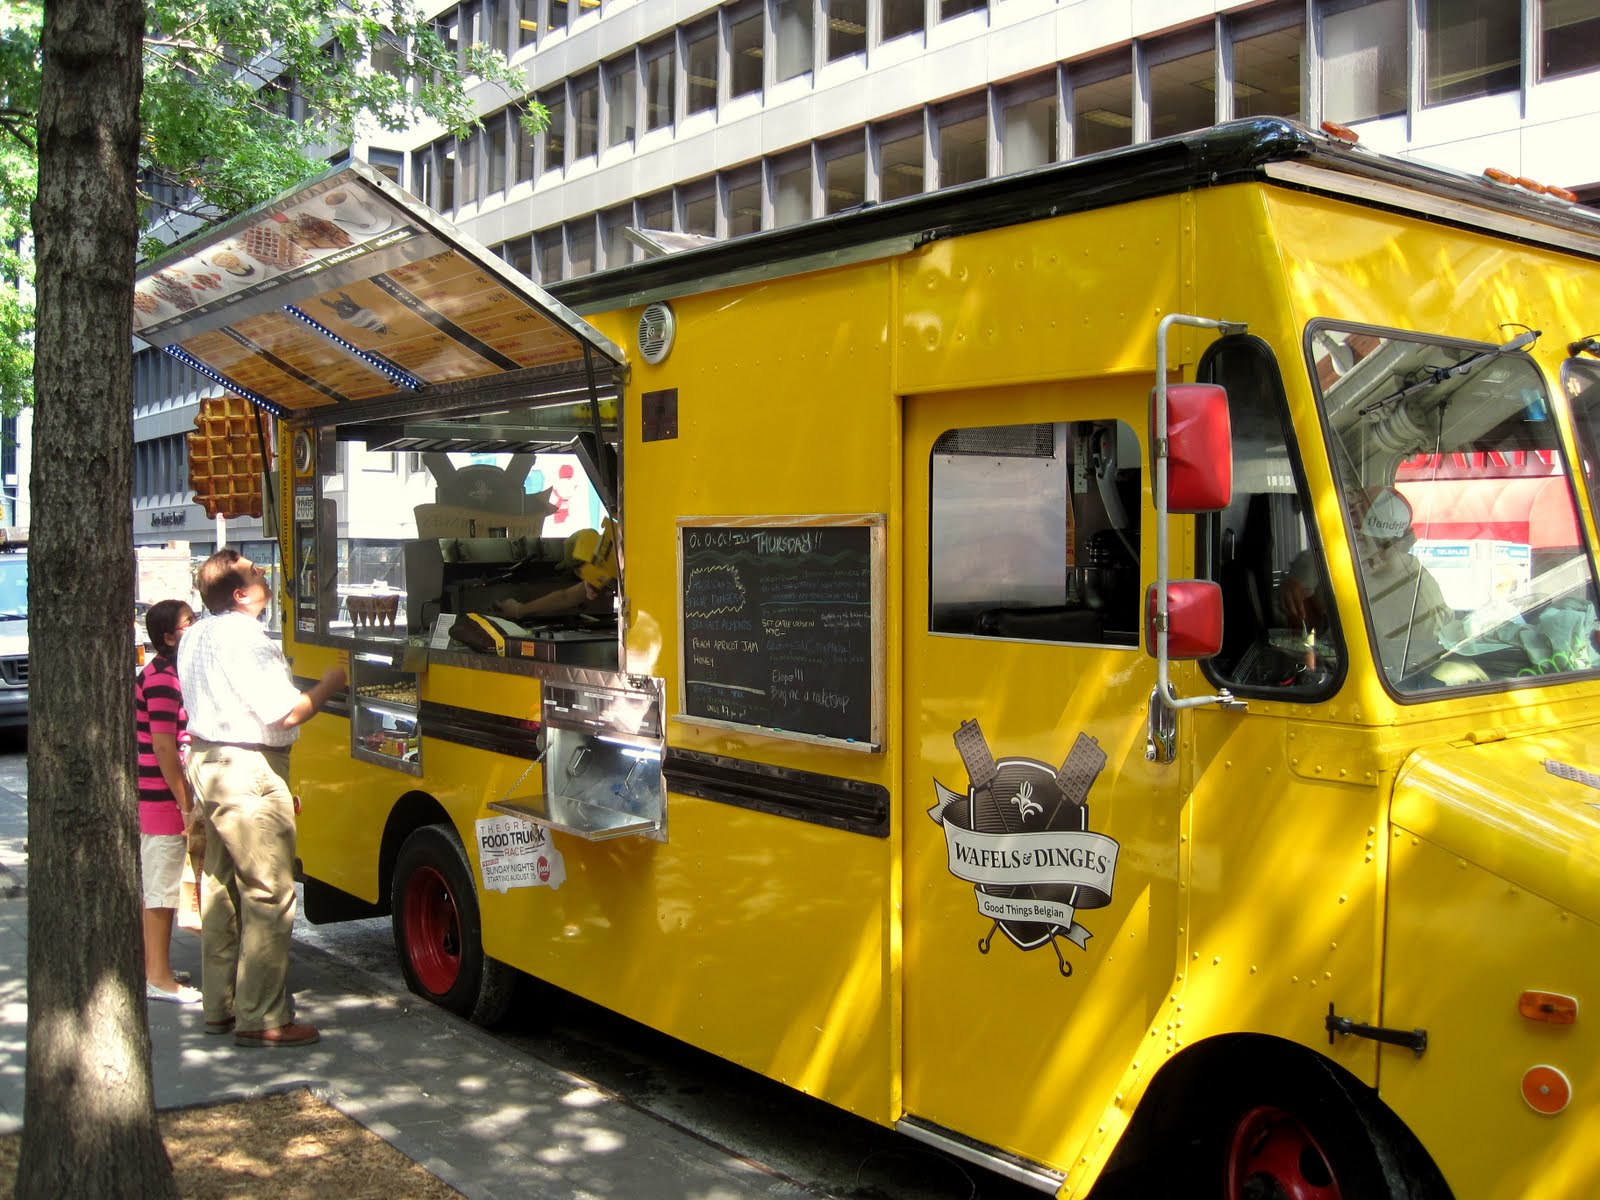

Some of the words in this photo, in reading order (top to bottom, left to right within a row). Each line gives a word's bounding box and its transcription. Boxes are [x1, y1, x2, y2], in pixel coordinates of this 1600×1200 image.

[692, 637, 711, 650] PEACH
[714, 640, 738, 652] APRICOT
[741, 641, 759, 653] JAM
[693, 654, 714, 667] HONEY
[480, 823, 502, 835] THE
[482, 834, 509, 849] FOOD
[504, 846, 526, 857] RACE
[954, 841, 1021, 869] WAFELS
[1022, 852, 1033, 866] &
[1033, 848, 1107, 875] DINGES
[486, 865, 510, 875] SUNDAY
[510, 863, 535, 873] NIGHTS
[984, 901, 1005, 914] Good
[1005, 904, 1033, 917] Things
[1034, 905, 1064, 919] Belgian
